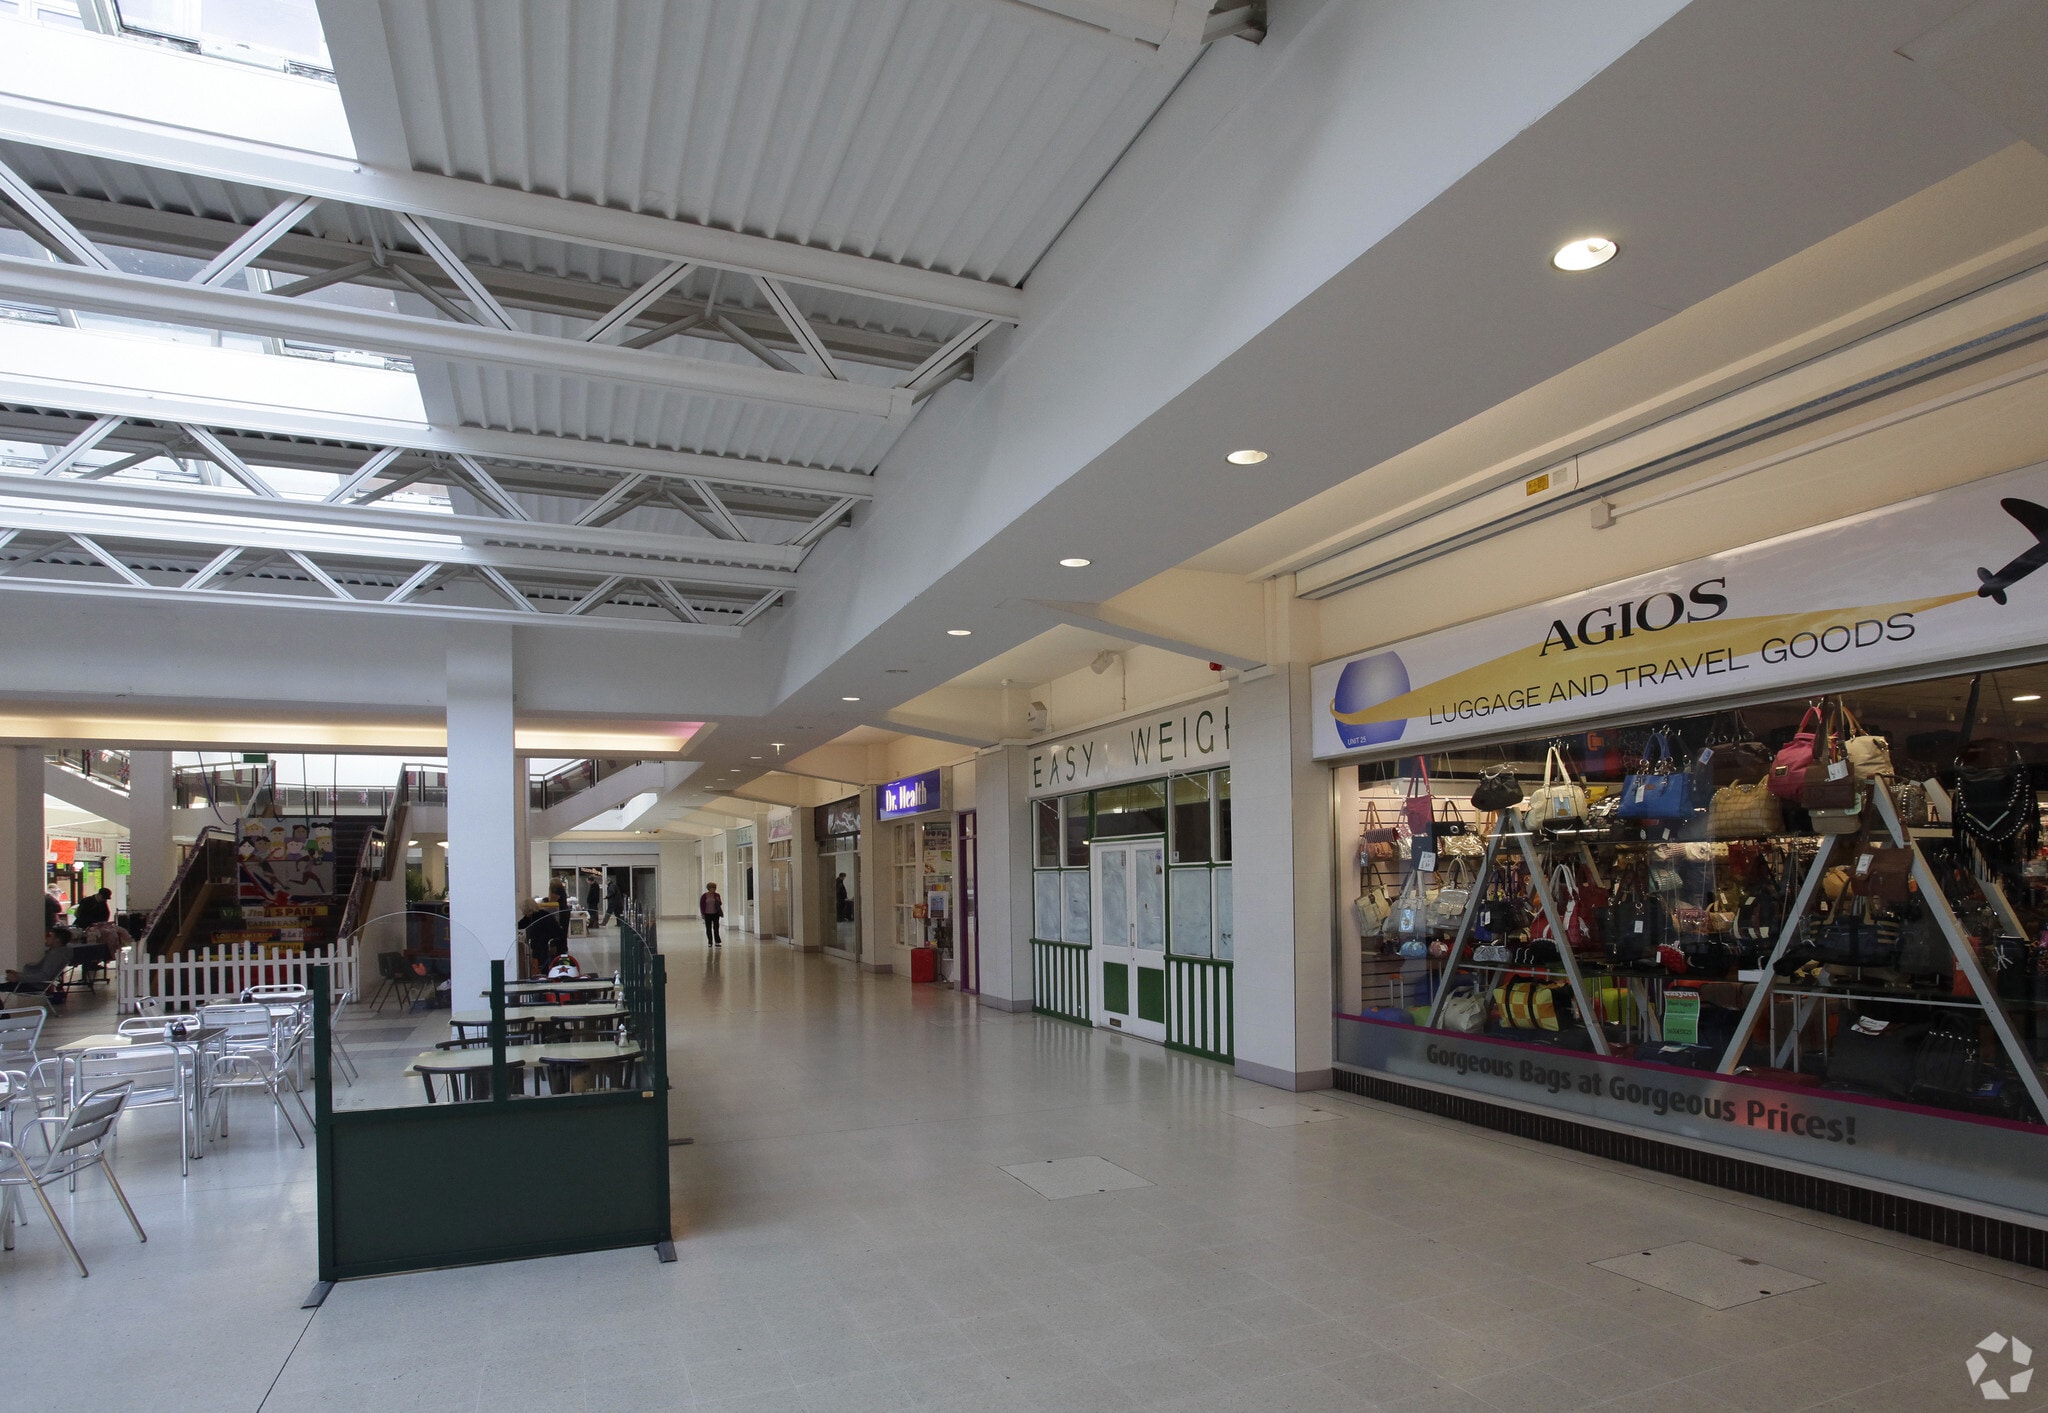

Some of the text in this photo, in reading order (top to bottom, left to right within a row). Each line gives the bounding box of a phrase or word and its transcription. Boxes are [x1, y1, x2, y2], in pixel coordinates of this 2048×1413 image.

[1539, 577, 1728, 657] AGIOS
[1429, 612, 1915, 725] LUGGAGE AND TRAVEL GOODS
[1347, 737, 1359, 745] UNIT
[1033, 741, 1094, 788] EASY
[885, 780, 927, 812] Dr. Health
[83, 837, 103, 853] MEATS
[275, 907, 317, 917] SPAIN
[1426, 1044, 1857, 1146] Gorgeous Bags at Gorgeous Prices!
